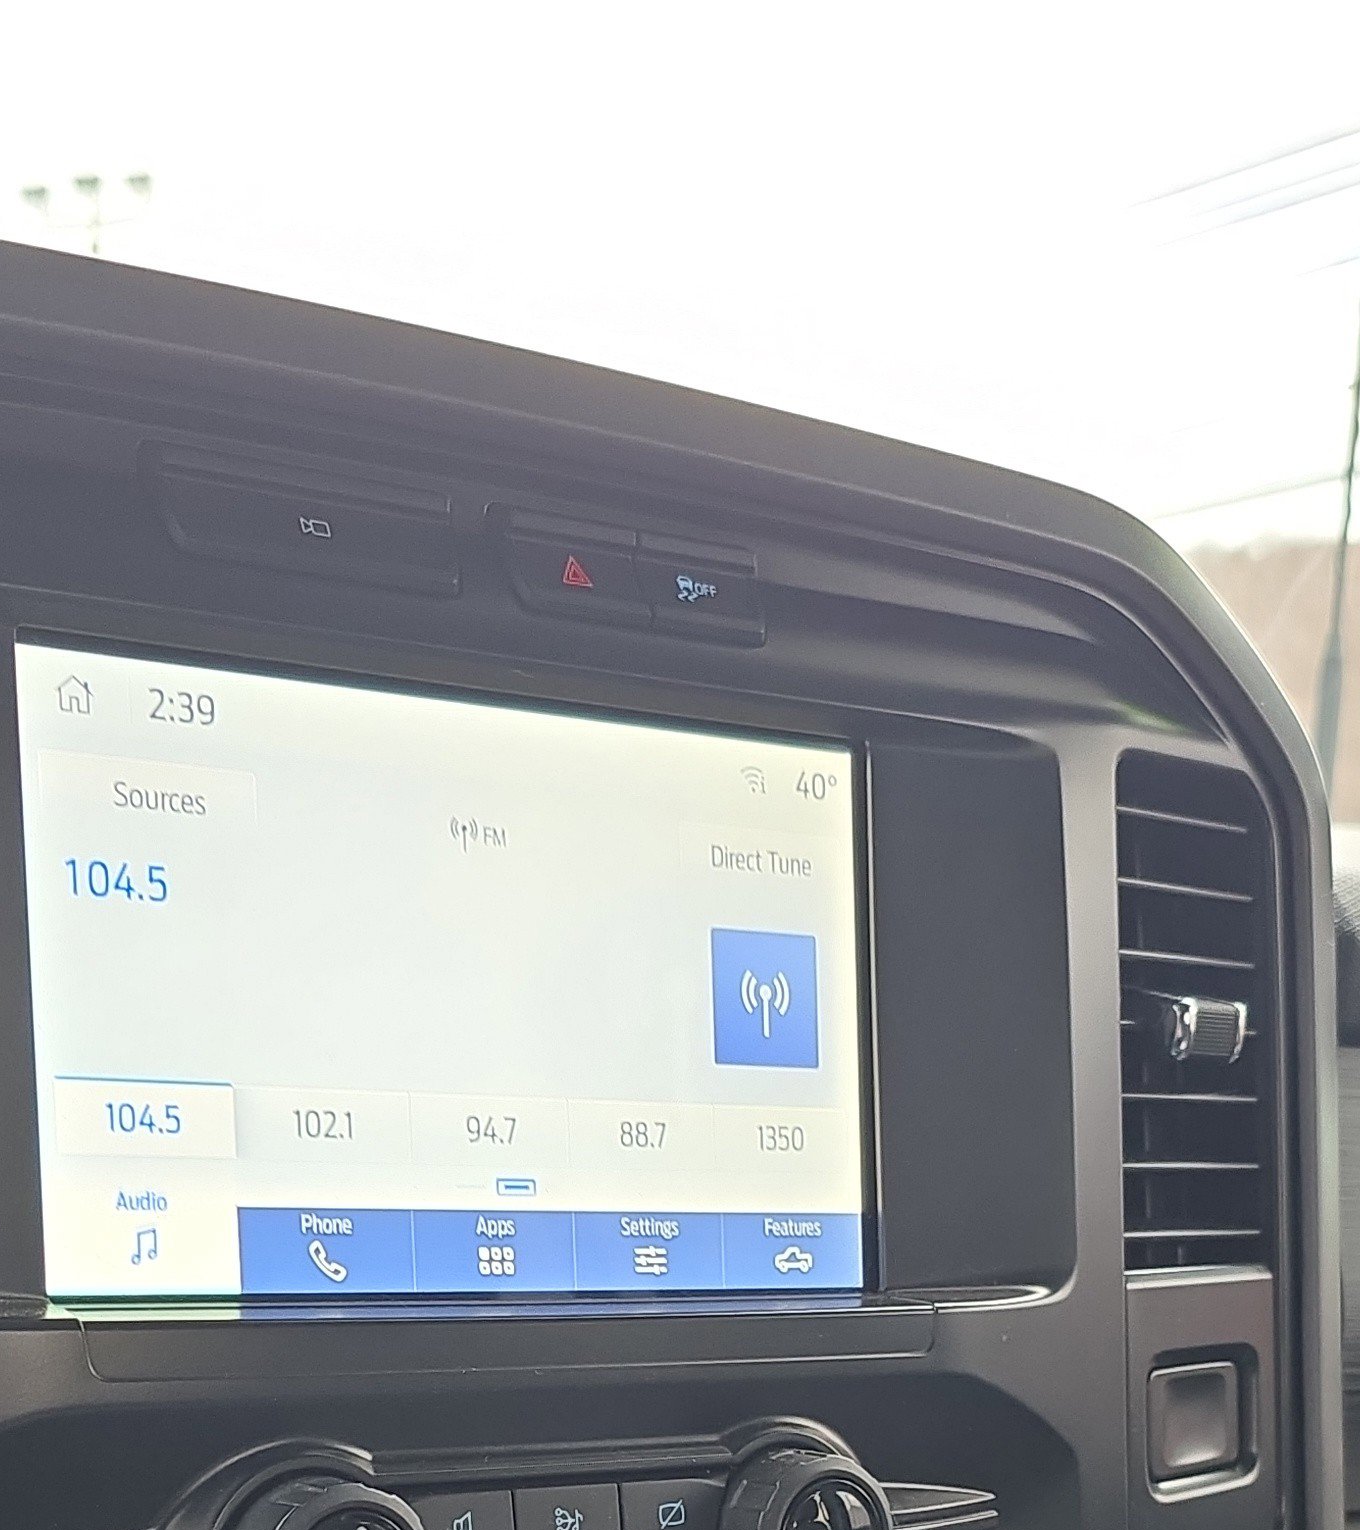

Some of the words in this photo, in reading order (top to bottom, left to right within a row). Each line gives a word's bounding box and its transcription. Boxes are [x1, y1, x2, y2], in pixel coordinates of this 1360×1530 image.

[694, 581, 717, 599] OFF
[148, 688, 216, 725] 2:39
[112, 780, 207, 816] Sources
[482, 825, 507, 848] FM
[711, 844, 762, 875] Direct
[768, 850, 812, 877] Tune
[64, 858, 168, 903] 104.5
[105, 1101, 181, 1135] 104.5
[293, 1107, 355, 1140] 102.1
[466, 1115, 517, 1147] 94.7
[619, 1120, 667, 1150] 88.7
[757, 1123, 805, 1153] 1350
[115, 1190, 168, 1212] Audio
[300, 1212, 353, 1236] Phone
[475, 1215, 516, 1238] Apps
[620, 1216, 680, 1240] Settings
[763, 1217, 822, 1239] Features
